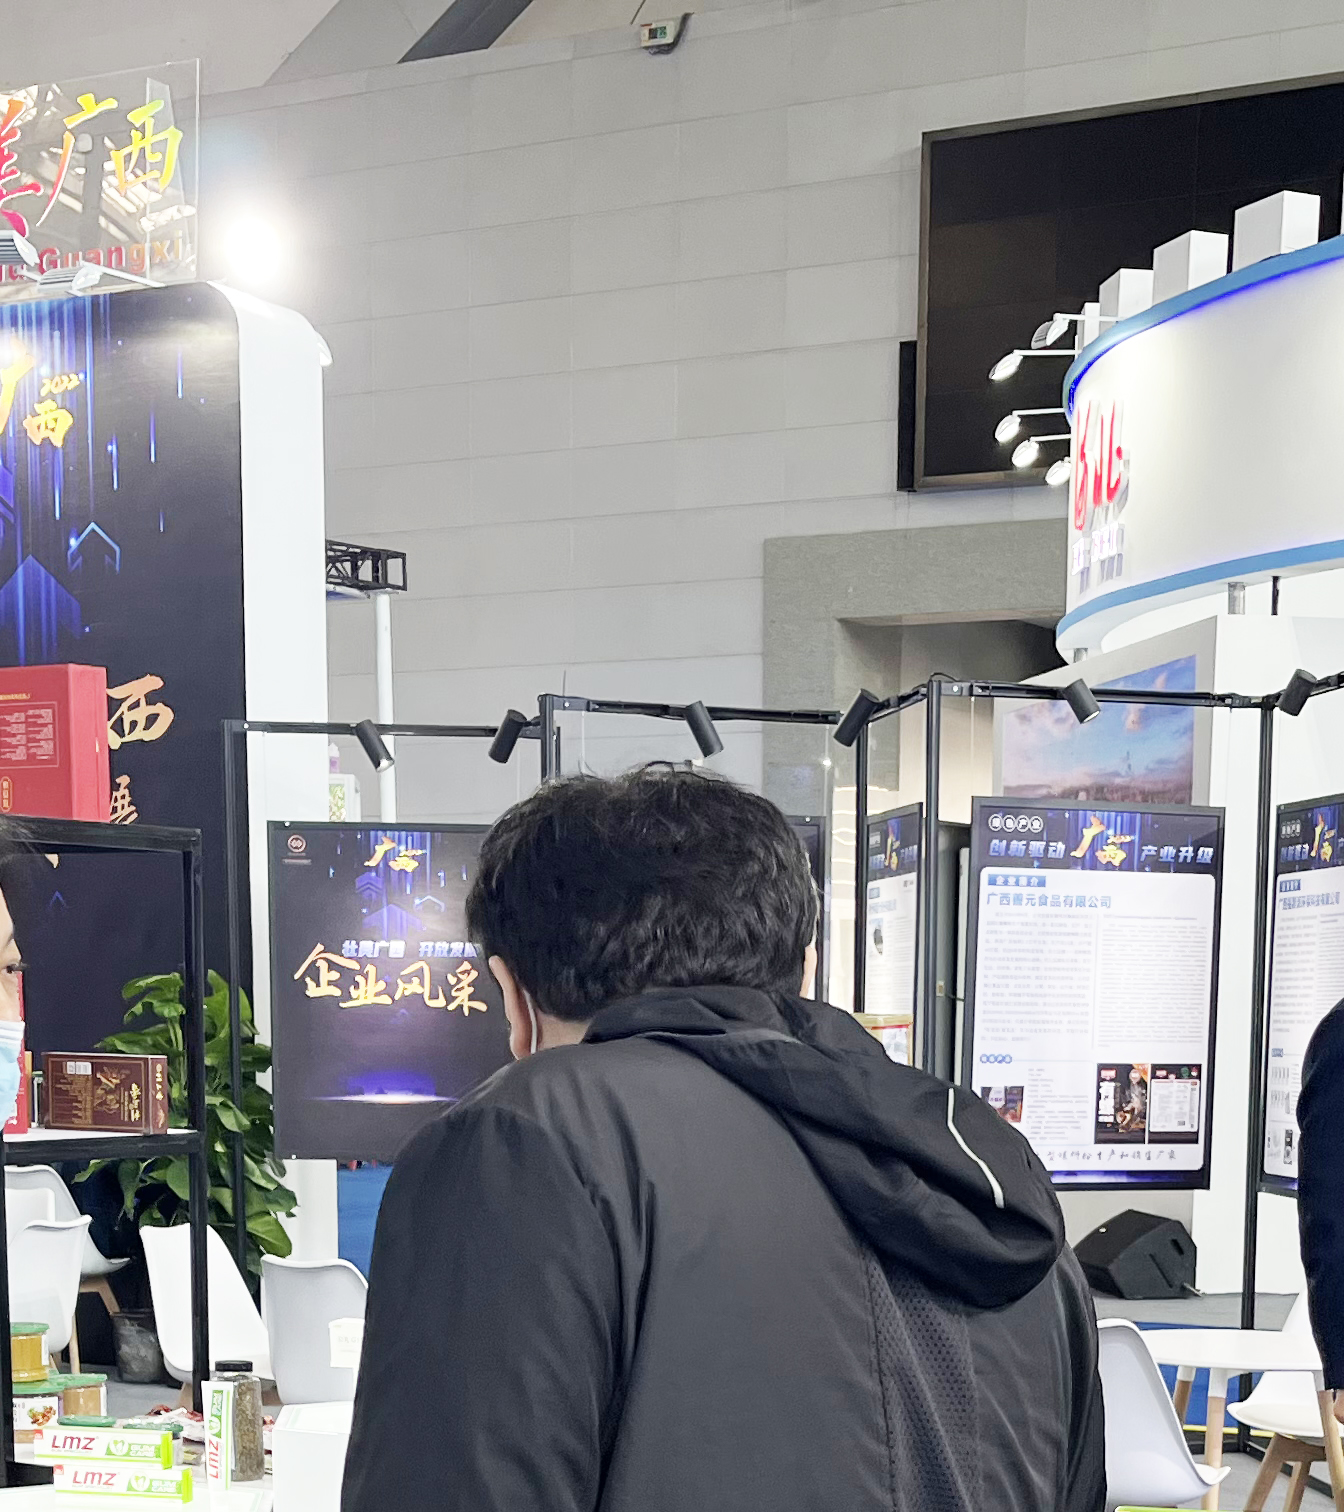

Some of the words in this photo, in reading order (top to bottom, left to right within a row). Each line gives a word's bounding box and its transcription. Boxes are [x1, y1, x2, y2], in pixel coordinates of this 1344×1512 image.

[988, 838, 1067, 860] 创新驱动
[1070, 814, 1128, 867] 广西
[1139, 844, 1214, 865] 产业升级
[293, 942, 488, 1017] 企业风采
[51, 1435, 96, 1451] LMZ
[72, 1470, 117, 1487] LMZ
